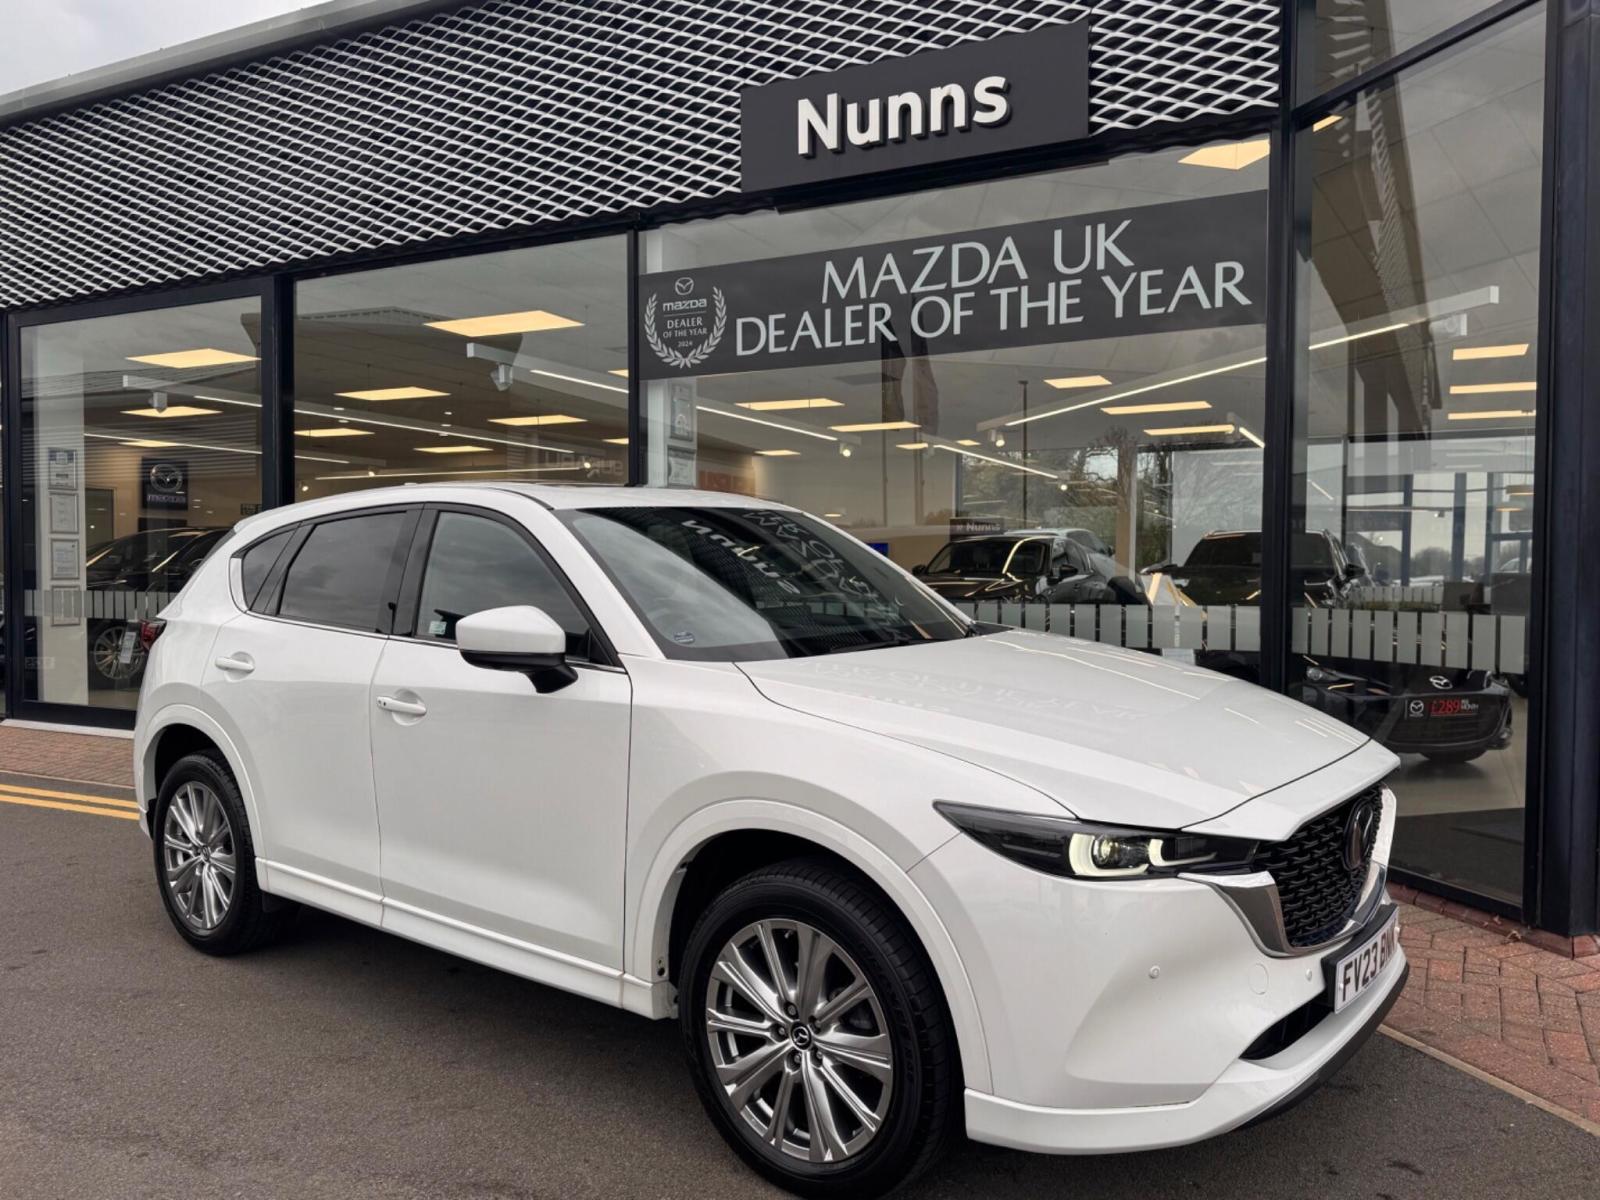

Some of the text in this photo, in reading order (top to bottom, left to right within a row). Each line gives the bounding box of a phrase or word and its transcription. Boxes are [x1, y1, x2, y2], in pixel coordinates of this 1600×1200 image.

[798, 76, 1010, 157] Nunns
[822, 219, 1135, 304] MAZDA UK
[662, 298, 708, 312] mazda
[667, 317, 703, 329] DEALER
[674, 329, 687, 337] THE
[689, 327, 708, 336] YEAR
[736, 261, 1252, 357] DEALER OF THE YEAR
[1342, 940, 1378, 1003] FV23
